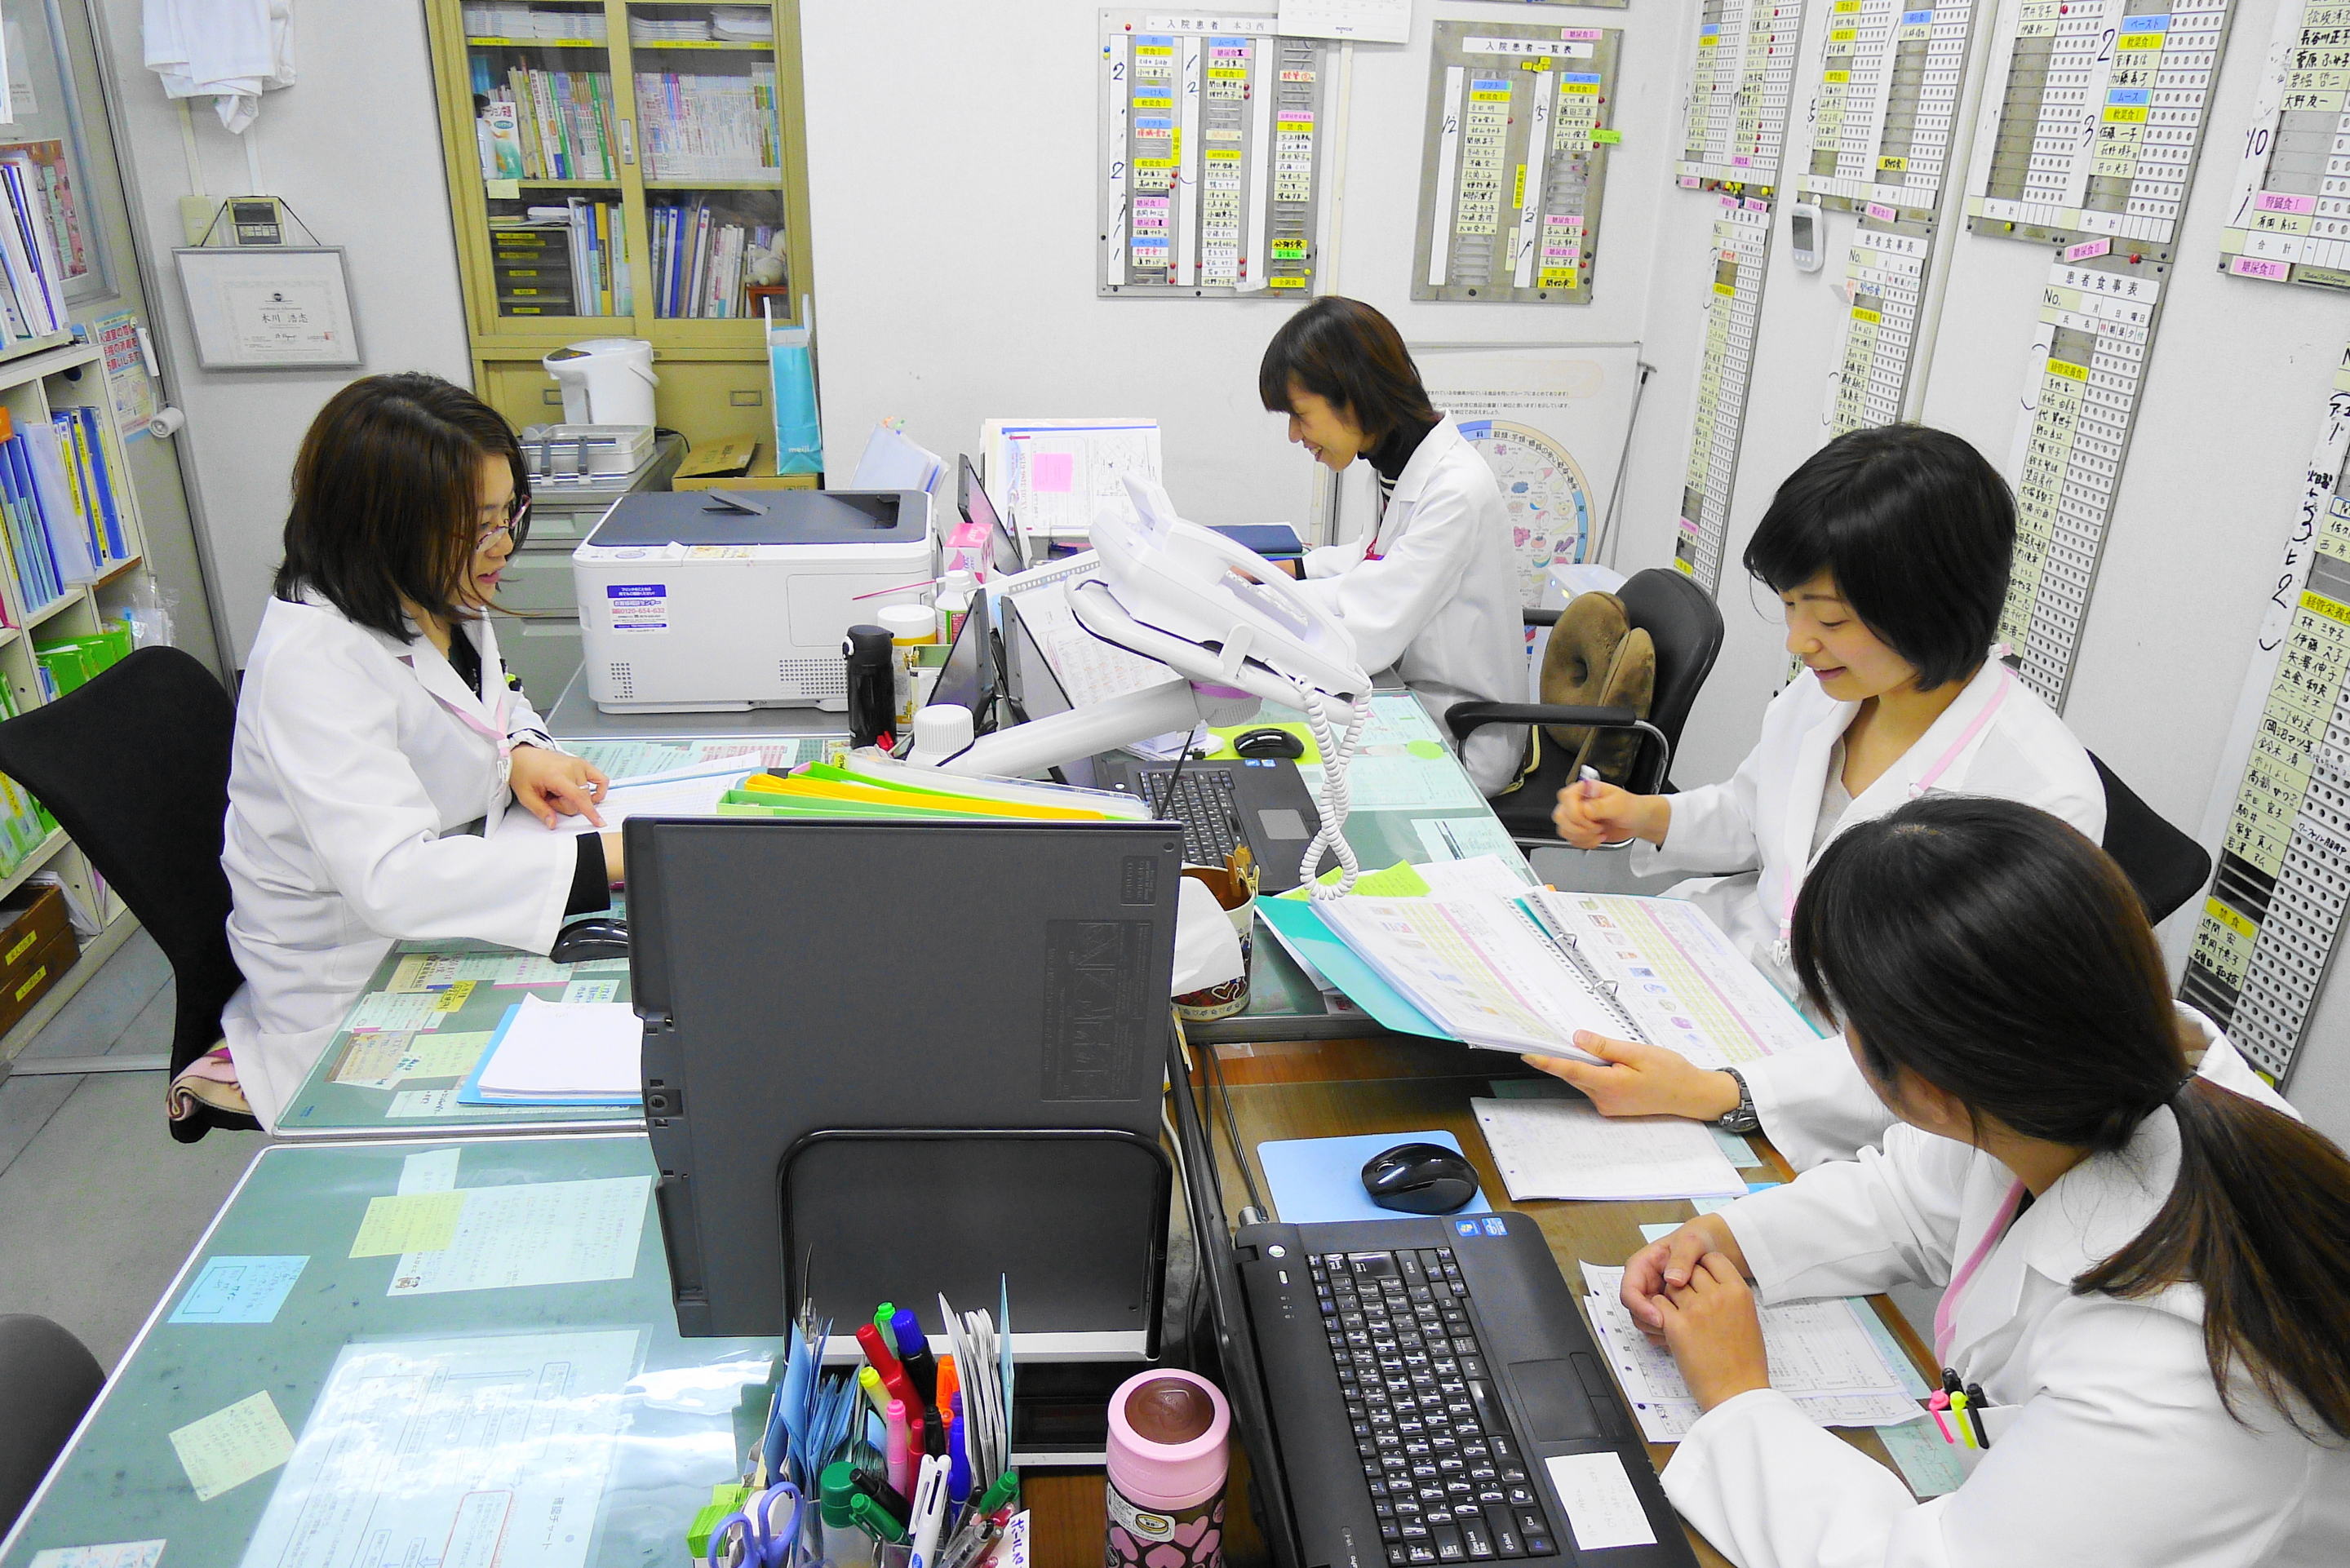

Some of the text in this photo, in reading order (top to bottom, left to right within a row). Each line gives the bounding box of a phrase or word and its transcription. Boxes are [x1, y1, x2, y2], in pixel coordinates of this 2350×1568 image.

[1167, 19, 1219, 30] 入院患者
[2131, 20, 2158, 30] ペースト
[1486, 41, 1572, 55] 入院患者一覧表
[2097, 29, 2115, 61] 2
[2126, 37, 2154, 47] 軟菜食Ⅰ
[1112, 61, 1125, 81] 2
[2118, 92, 2139, 102] ムース
[1536, 105, 1547, 122] 5
[1442, 116, 1457, 134] 12
[2082, 115, 2095, 148] 3
[2246, 126, 2268, 159] 10
[1111, 161, 1125, 179] 2
[1865, 233, 1914, 254] 患者食事表
[2073, 242, 2099, 258] 糖尿食Ⅱ
[2241, 259, 2275, 276] 糖尿食Ⅱ
[2065, 271, 2138, 296] 患者食事表
[2043, 288, 2061, 306] No.
[2131, 312, 2146, 323] 曜日
[2051, 361, 2083, 379] 経管栄養食
[788, 445, 809, 453] meiji
[2272, 574, 2292, 609] 2
[2219, 907, 2240, 929] 禁食
